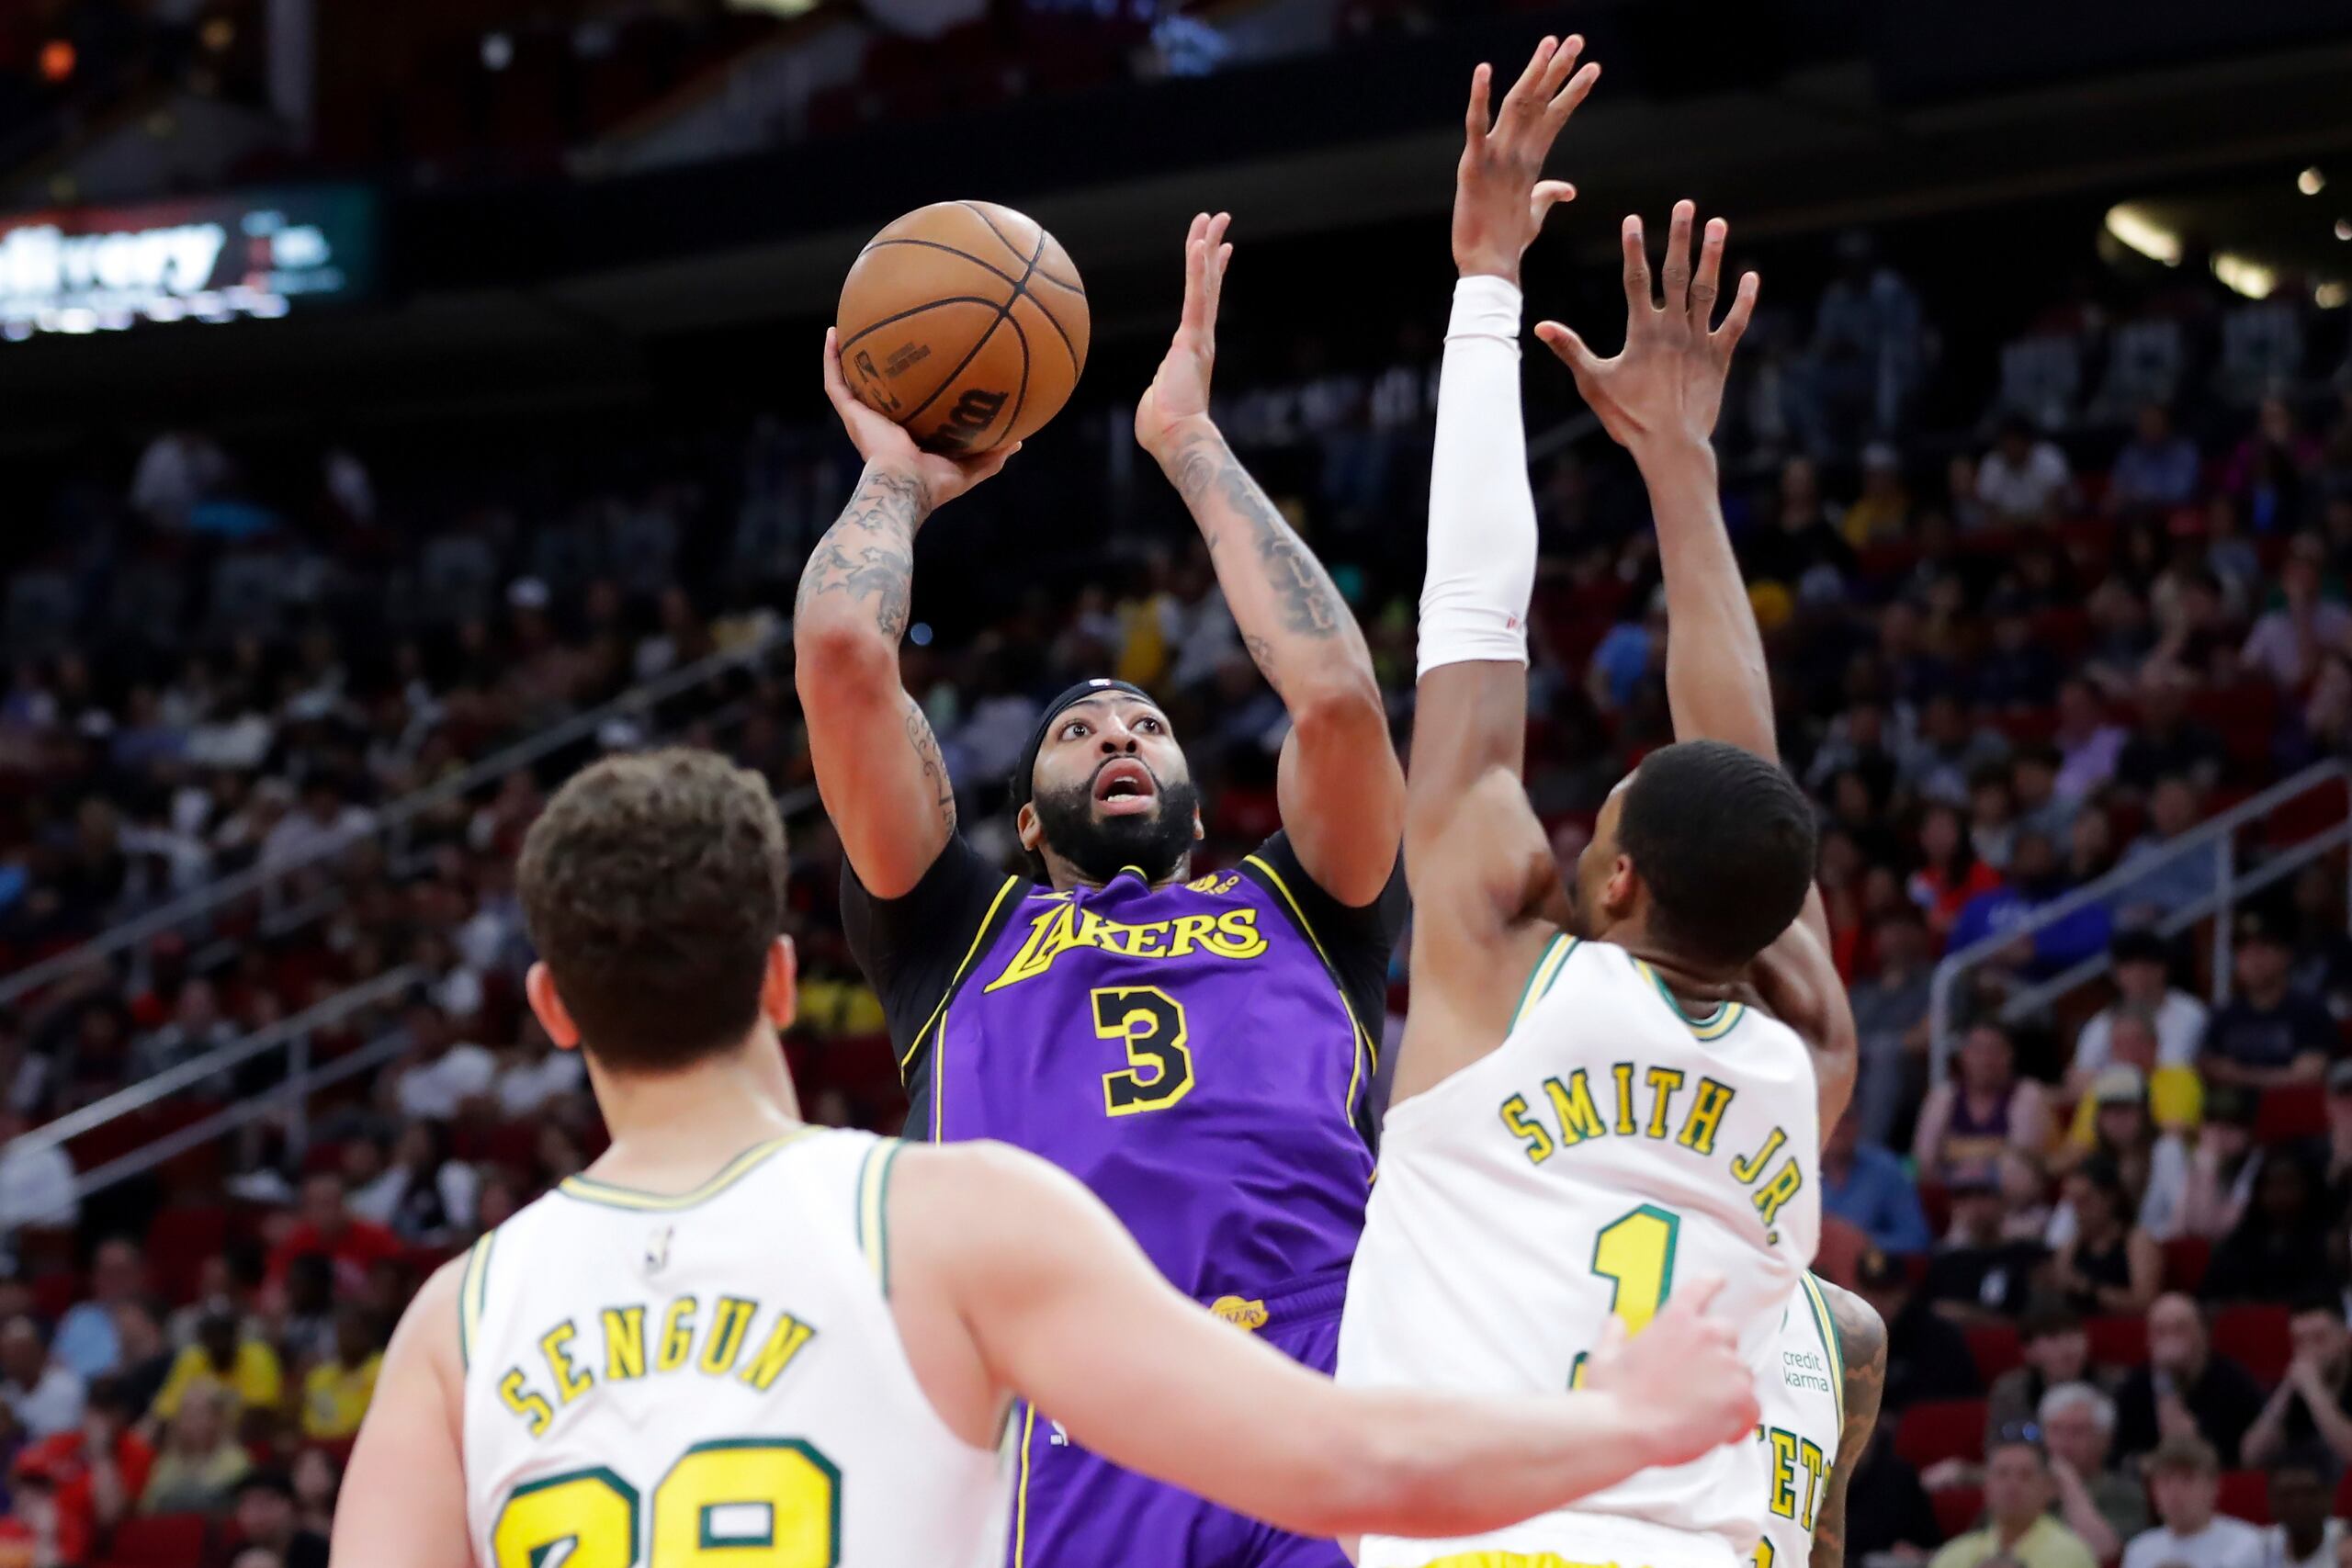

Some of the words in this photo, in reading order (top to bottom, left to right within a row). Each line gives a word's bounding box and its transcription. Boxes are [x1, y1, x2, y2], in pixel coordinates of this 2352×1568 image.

[981, 901, 1270, 995] LAKERS
[1090, 985, 1196, 1117] 3
[1499, 1061, 1736, 1166] SMITH
[1729, 1126, 1804, 1246] JR.
[1572, 1203, 1680, 1392] 1
[1782, 1351, 1822, 1371] credit
[497, 1294, 818, 1438] SENGUN
[1782, 1366, 1829, 1393] karma
